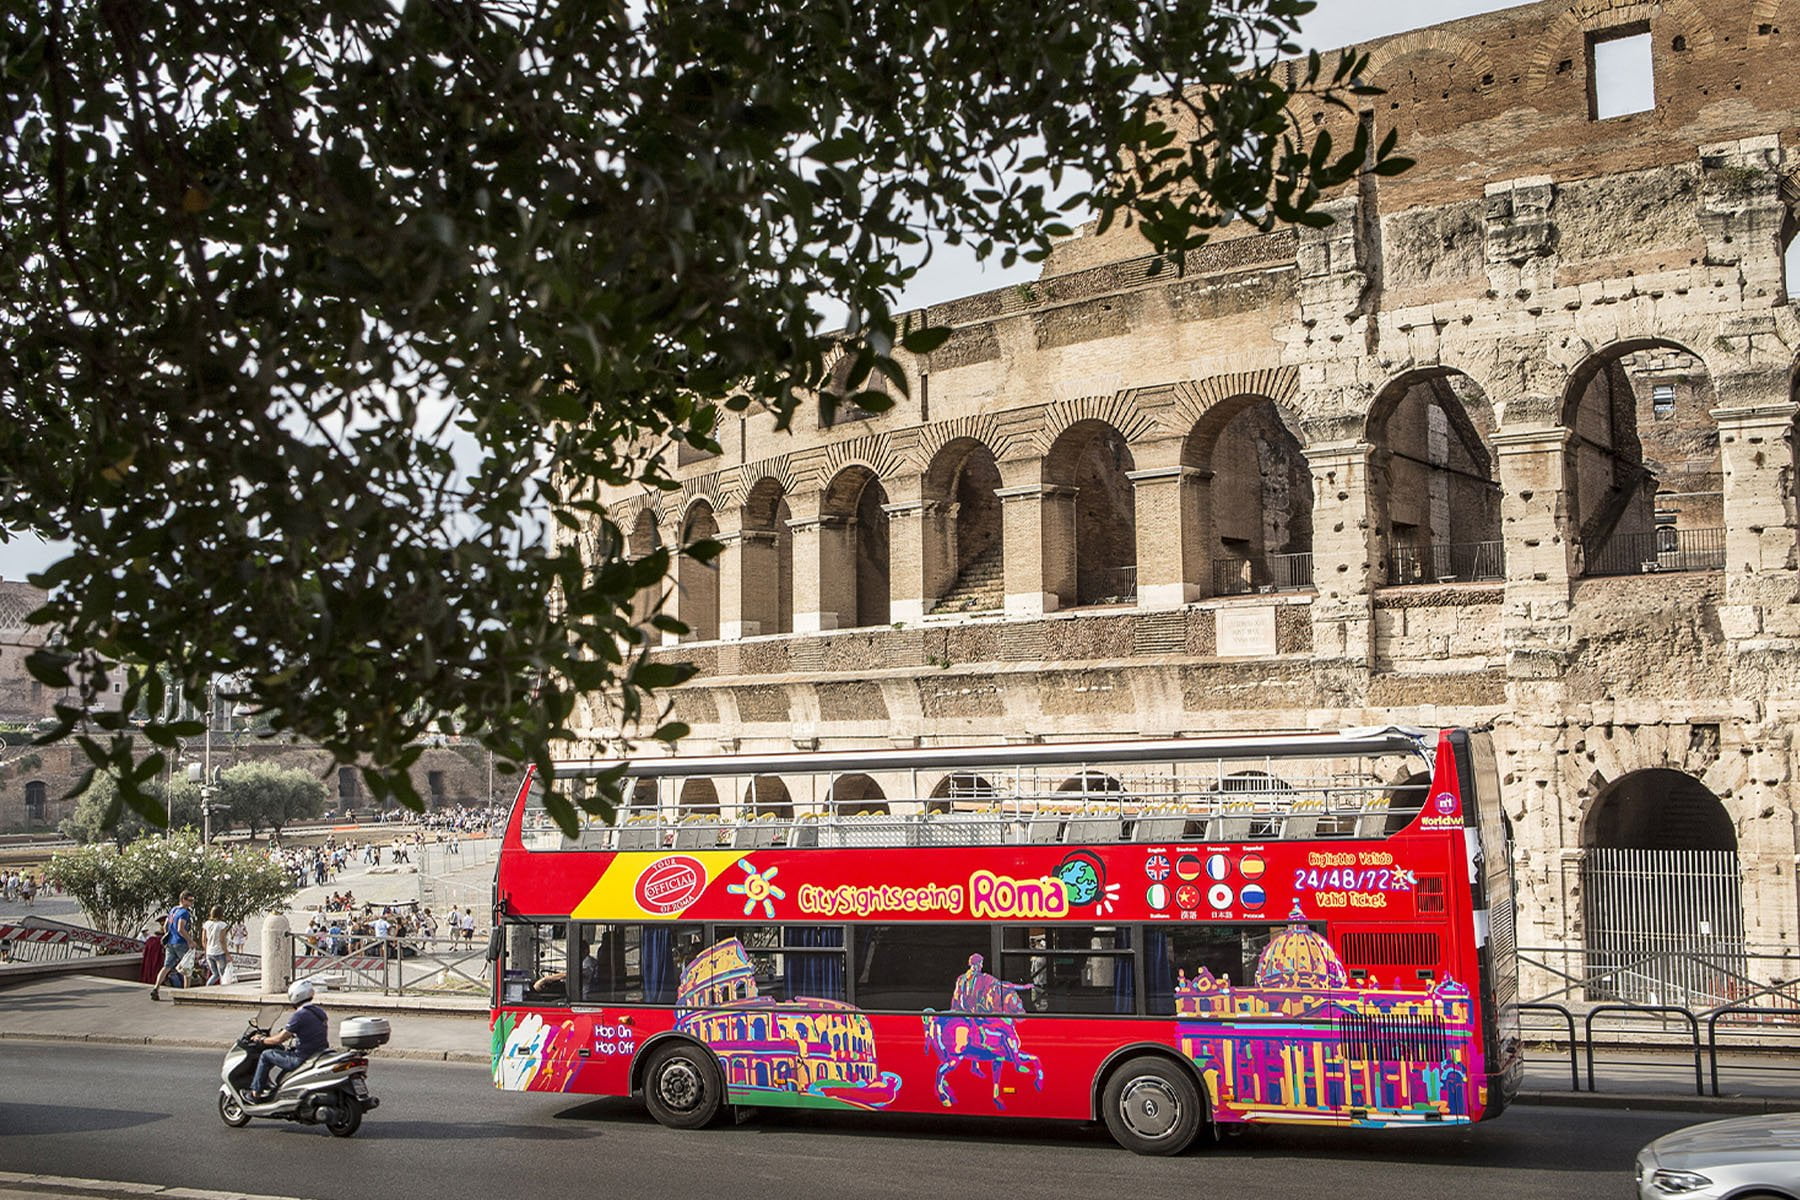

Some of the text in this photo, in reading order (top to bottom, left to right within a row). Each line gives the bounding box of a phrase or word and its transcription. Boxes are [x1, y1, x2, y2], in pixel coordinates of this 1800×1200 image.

[652, 858, 677, 871] TOUR
[1308, 851, 1393, 868] Biglietto Valido
[646, 873, 694, 898] OFFICIAL
[1294, 868, 1390, 890] 24/48/72
[969, 870, 1069, 918] Roma
[1315, 891, 1388, 908] Valid Ticket
[671, 896, 695, 912] ROMA
[594, 1024, 632, 1039] Hop On
[595, 1041, 635, 1055] Hop Off
